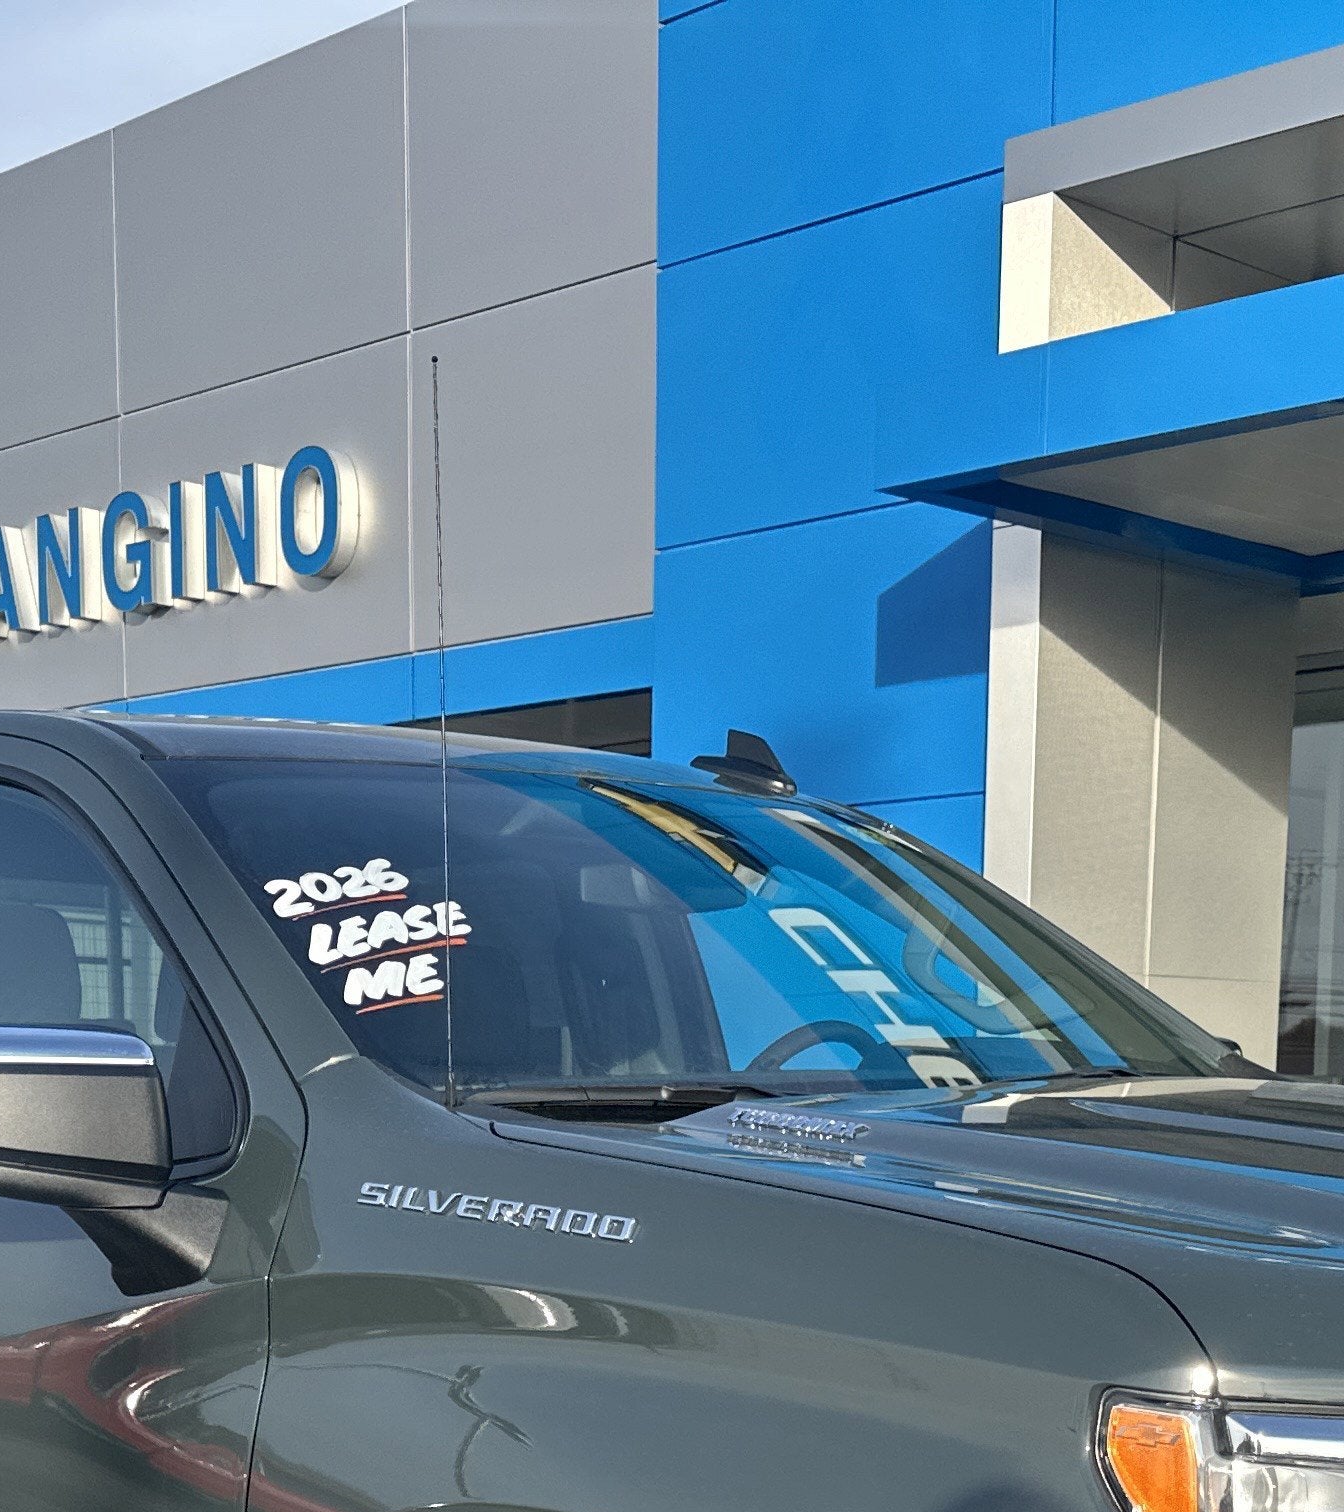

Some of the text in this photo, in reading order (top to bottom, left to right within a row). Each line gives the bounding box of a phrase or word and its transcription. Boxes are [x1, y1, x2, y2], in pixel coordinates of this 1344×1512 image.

[264, 858, 409, 918] 2026
[308, 901, 472, 965] LEASE
[343, 953, 444, 1005] ME
[357, 1182, 637, 1242] SILVERADO
